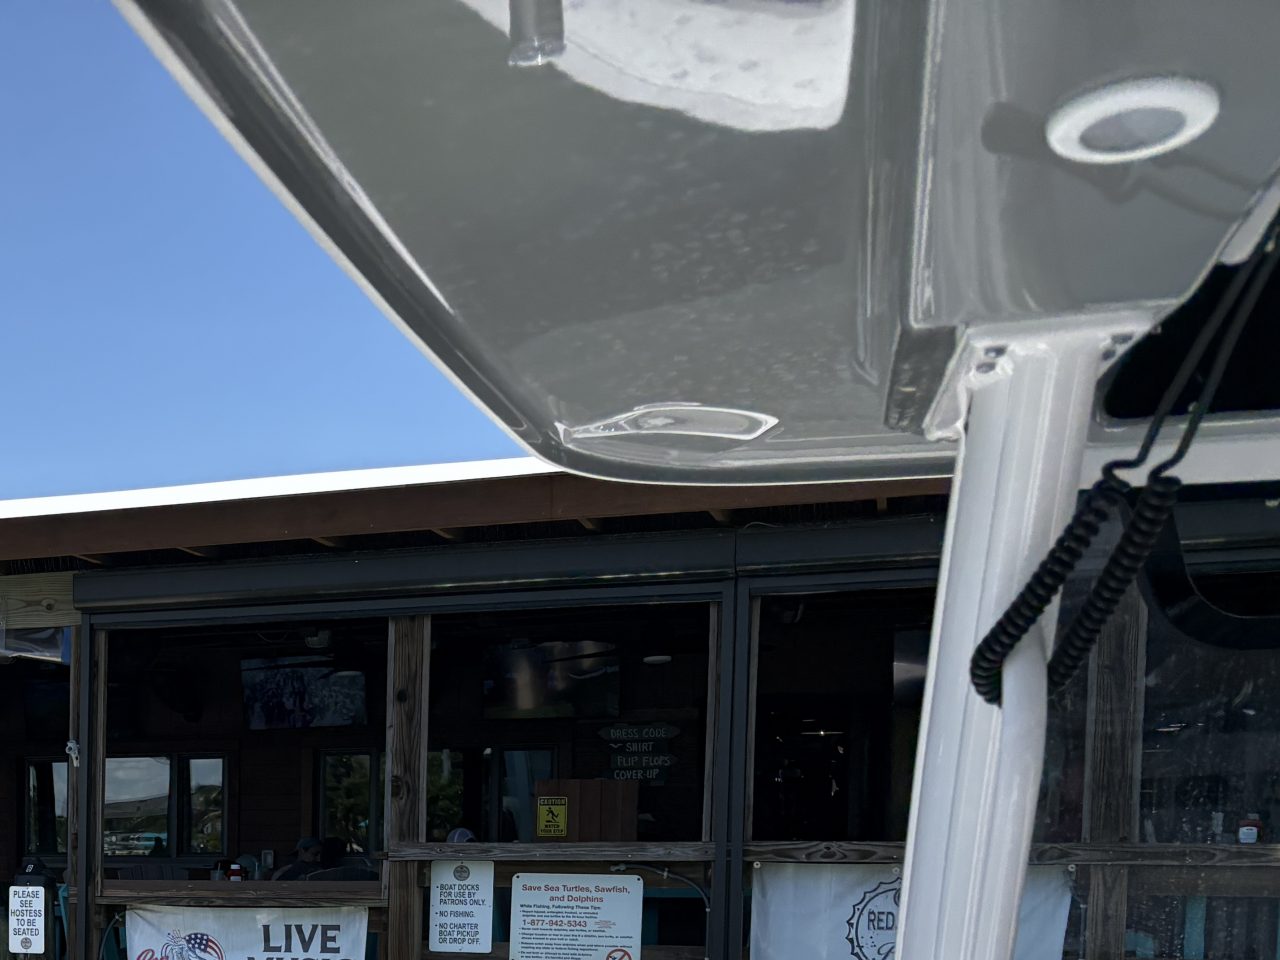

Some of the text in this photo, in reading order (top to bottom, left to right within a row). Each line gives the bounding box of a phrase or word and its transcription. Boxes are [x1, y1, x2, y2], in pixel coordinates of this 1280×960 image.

[610, 728, 668, 738] DRESS CODE
[625, 742, 655, 752] SHIRT
[617, 755, 672, 766] FLIP FLOPS
[562, 885, 592, 893] Turtles,
[594, 886, 630, 894] Sawfish,
[13, 891, 39, 899] PLEASE
[567, 895, 603, 903] Dolphins
[20, 900, 33, 908] SEE
[10, 909, 42, 917] HOSTESS
[16, 918, 36, 927] TO BE
[522, 919, 587, 928] 1-877-942-5343
[868, 911, 896, 930] RED
[13, 928, 39, 936] SEATED
[262, 924, 341, 954] LIVE
